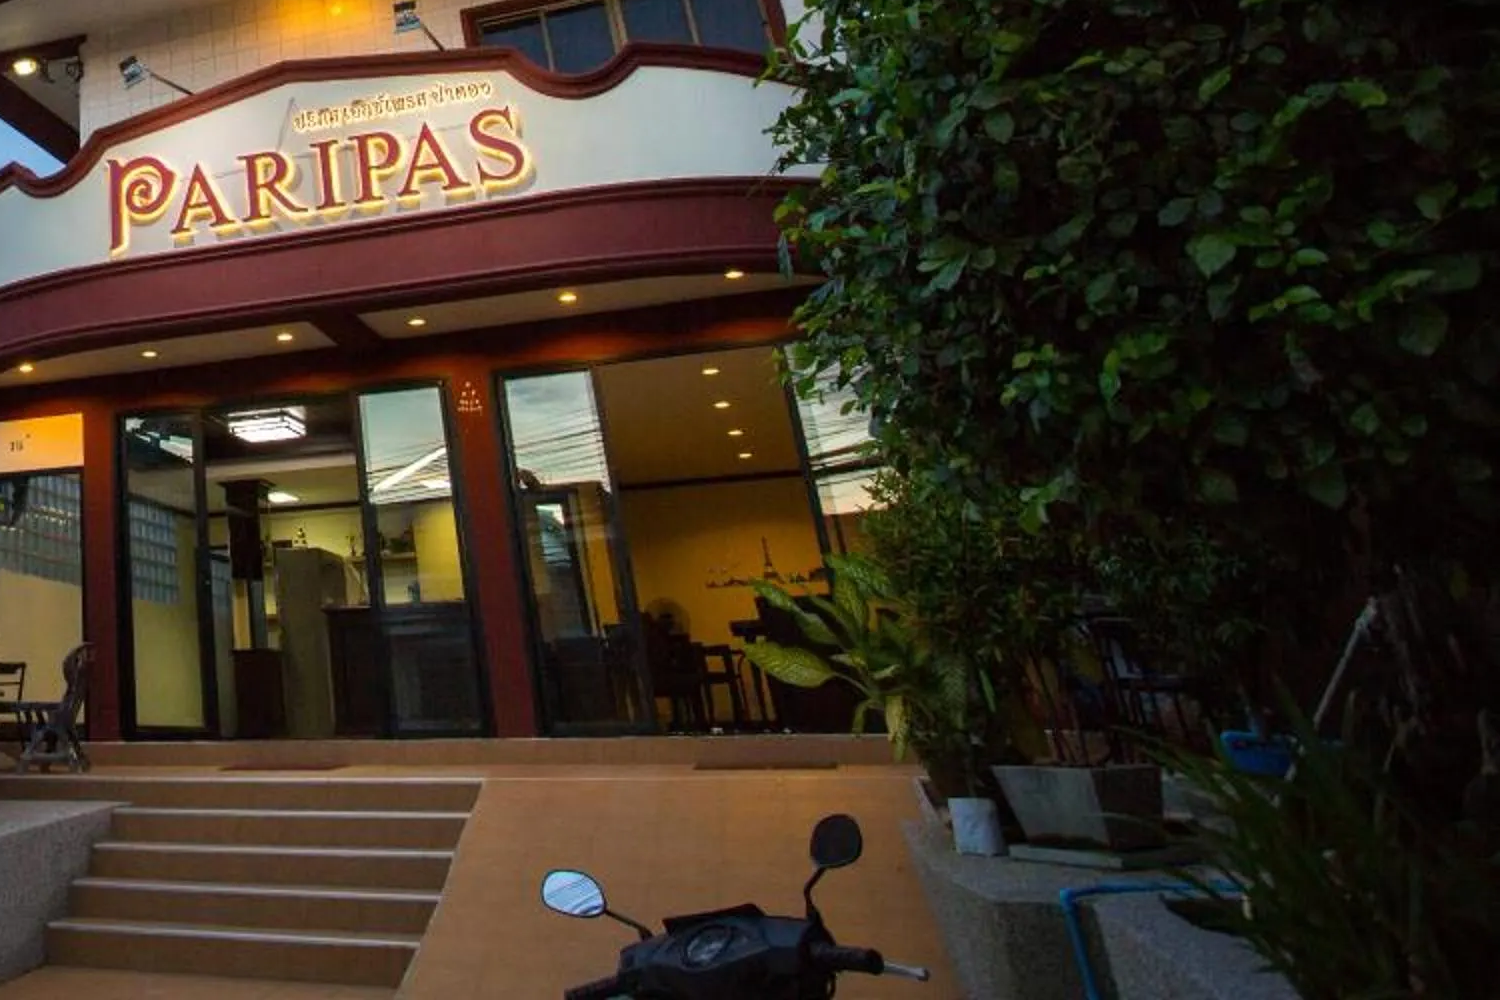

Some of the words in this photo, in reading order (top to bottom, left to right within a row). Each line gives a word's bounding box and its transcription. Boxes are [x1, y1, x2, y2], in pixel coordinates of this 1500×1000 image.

[430, 80, 492, 104] ป่าตอง
[106, 104, 529, 253] PARIPAS
